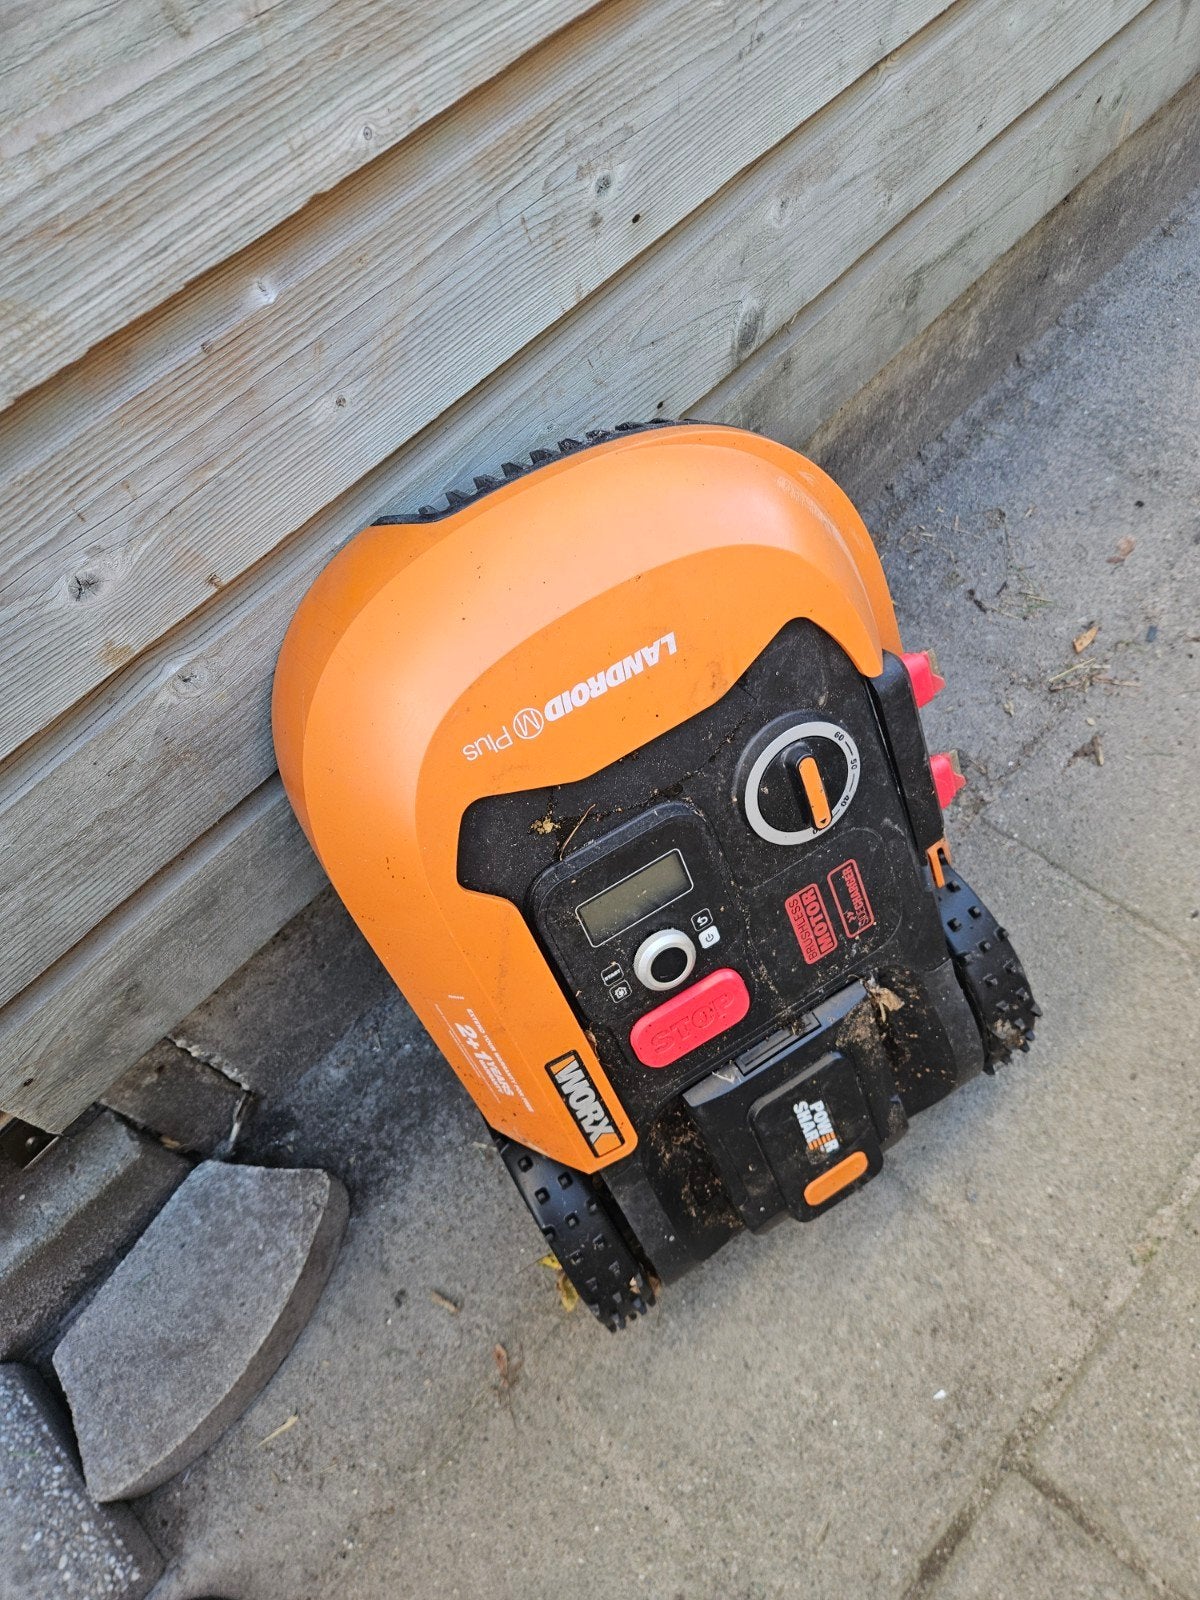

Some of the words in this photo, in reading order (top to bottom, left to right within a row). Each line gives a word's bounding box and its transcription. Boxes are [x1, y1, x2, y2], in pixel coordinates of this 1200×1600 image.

[544, 631, 677, 722] LANDROID
[462, 725, 514, 761] Plus
[834, 731, 845, 742] 60
[850, 758, 858, 770] 50
[789, 899, 818, 960] BRUSHLESS
[801, 888, 834, 953] MOTOR
[466, 1008, 486, 1034] EXTEND
[483, 1034, 497, 1052] YOUR
[651, 992, 735, 1054] STOP
[555, 1060, 615, 1144] WORX
[793, 1101, 822, 1150] SHARE
[809, 1100, 840, 1153] POWER
